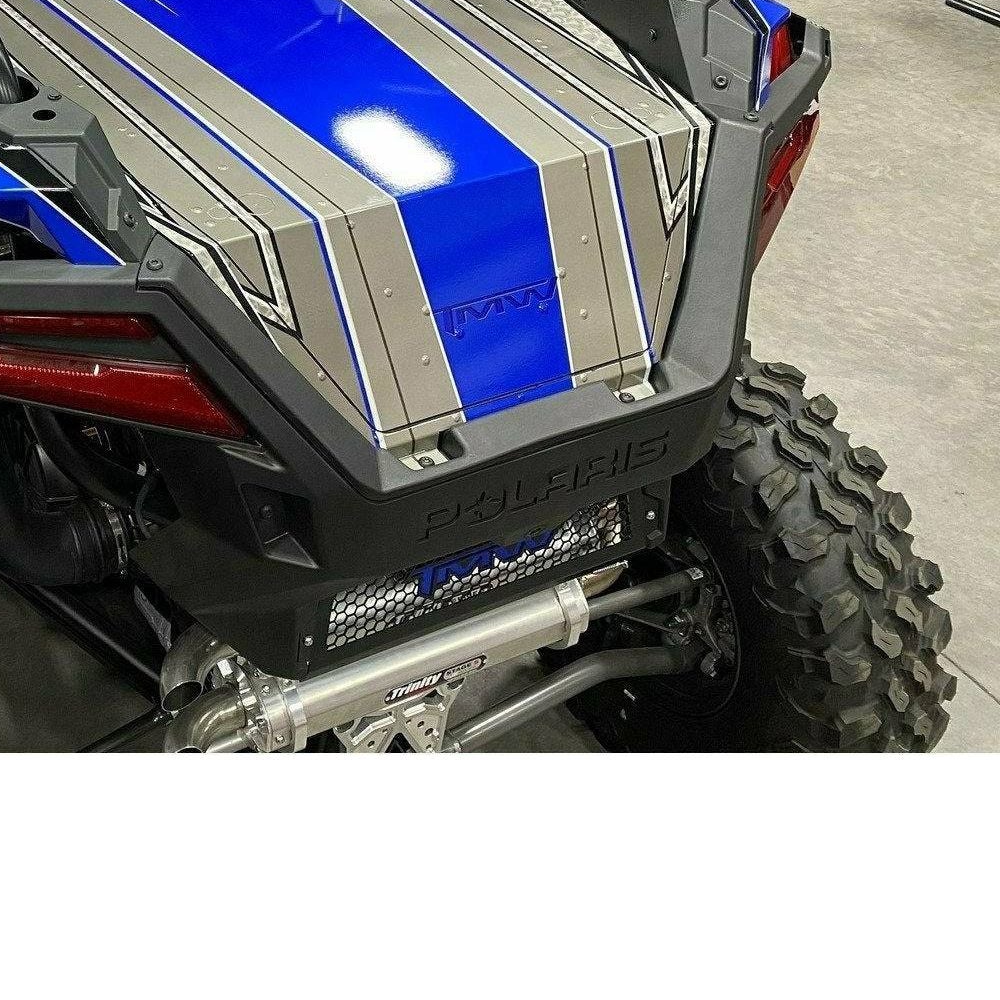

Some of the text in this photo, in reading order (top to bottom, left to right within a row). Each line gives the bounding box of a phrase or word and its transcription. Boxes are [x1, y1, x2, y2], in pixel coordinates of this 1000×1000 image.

[432, 278, 558, 337] TMW
[416, 429, 671, 544] POLARIS
[410, 529, 555, 598] TMW
[385, 671, 443, 702] Trinity
